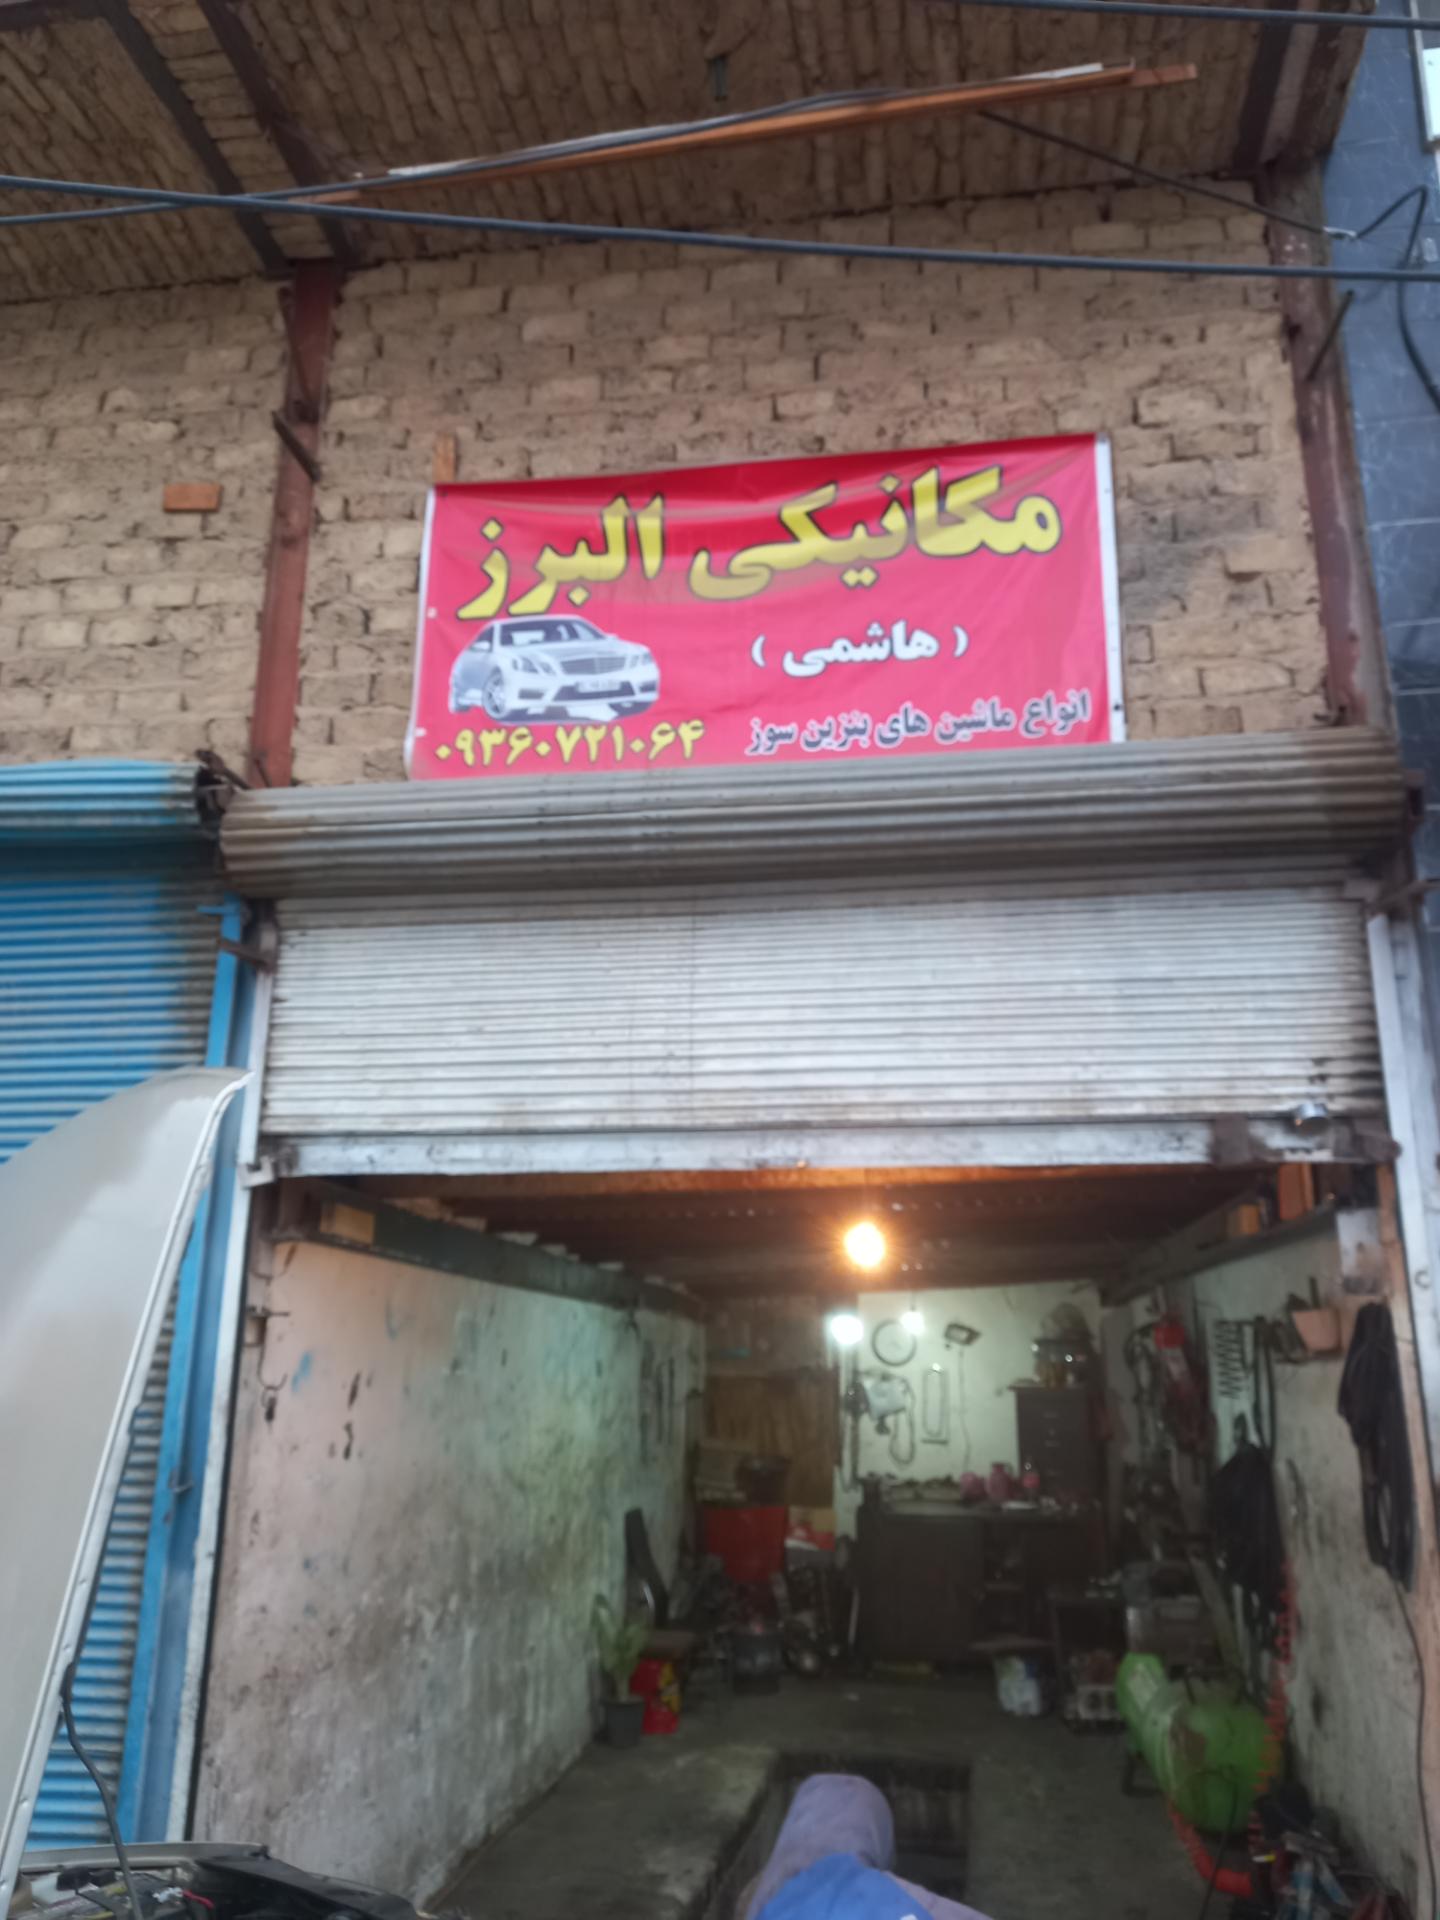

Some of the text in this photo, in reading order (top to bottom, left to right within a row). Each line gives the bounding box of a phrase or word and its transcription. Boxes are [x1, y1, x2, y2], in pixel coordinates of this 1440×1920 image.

[456, 464, 1061, 620] مکانیکی البرز
[782, 619, 940, 677] هاشمی
[745, 687, 1093, 756] انواع ماشین های بنزین سوز
